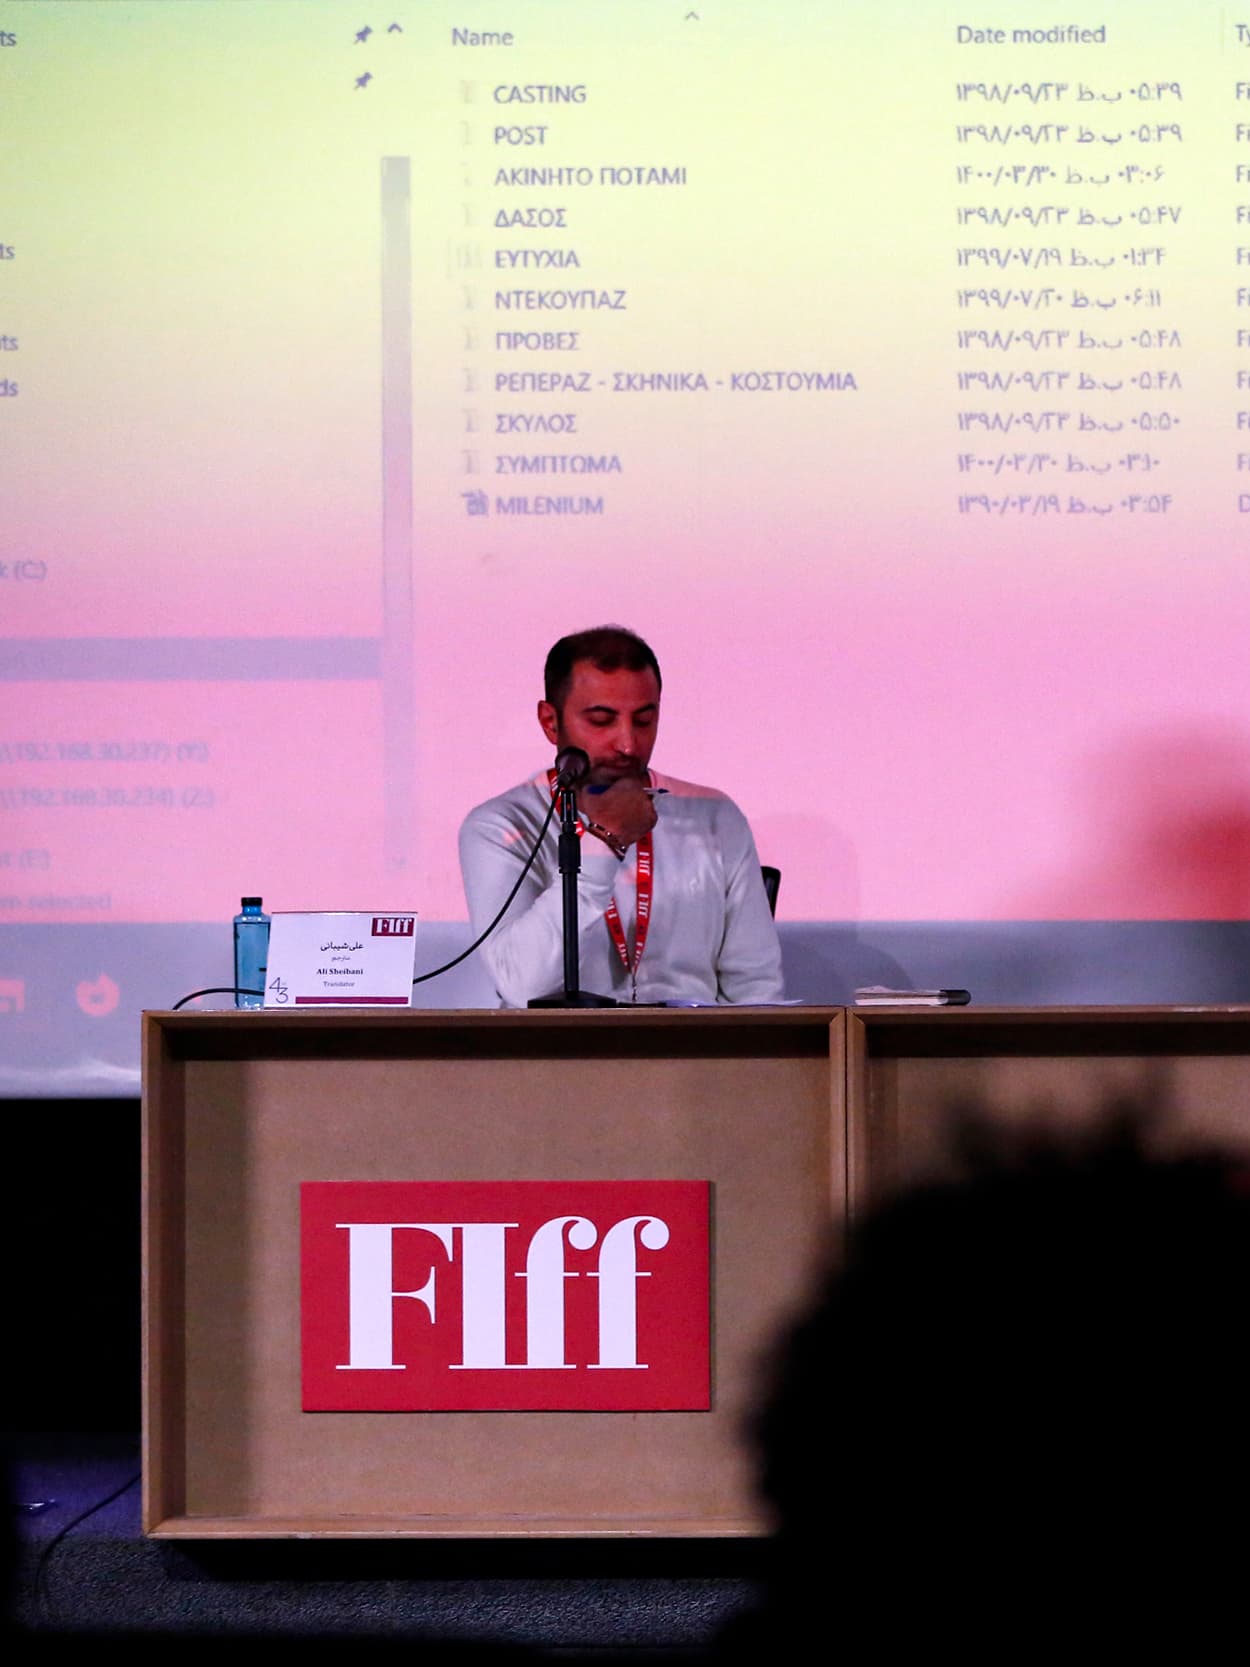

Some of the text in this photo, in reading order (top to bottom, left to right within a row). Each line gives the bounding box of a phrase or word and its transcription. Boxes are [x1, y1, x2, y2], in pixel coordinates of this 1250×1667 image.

[452, 27, 514, 47] Name
[957, 24, 1106, 44] Date modified
[493, 84, 587, 104] CASTING
[493, 125, 548, 146] POST
[496, 495, 604, 515] MILENIUM
[320, 941, 364, 952] علی شیبانی
